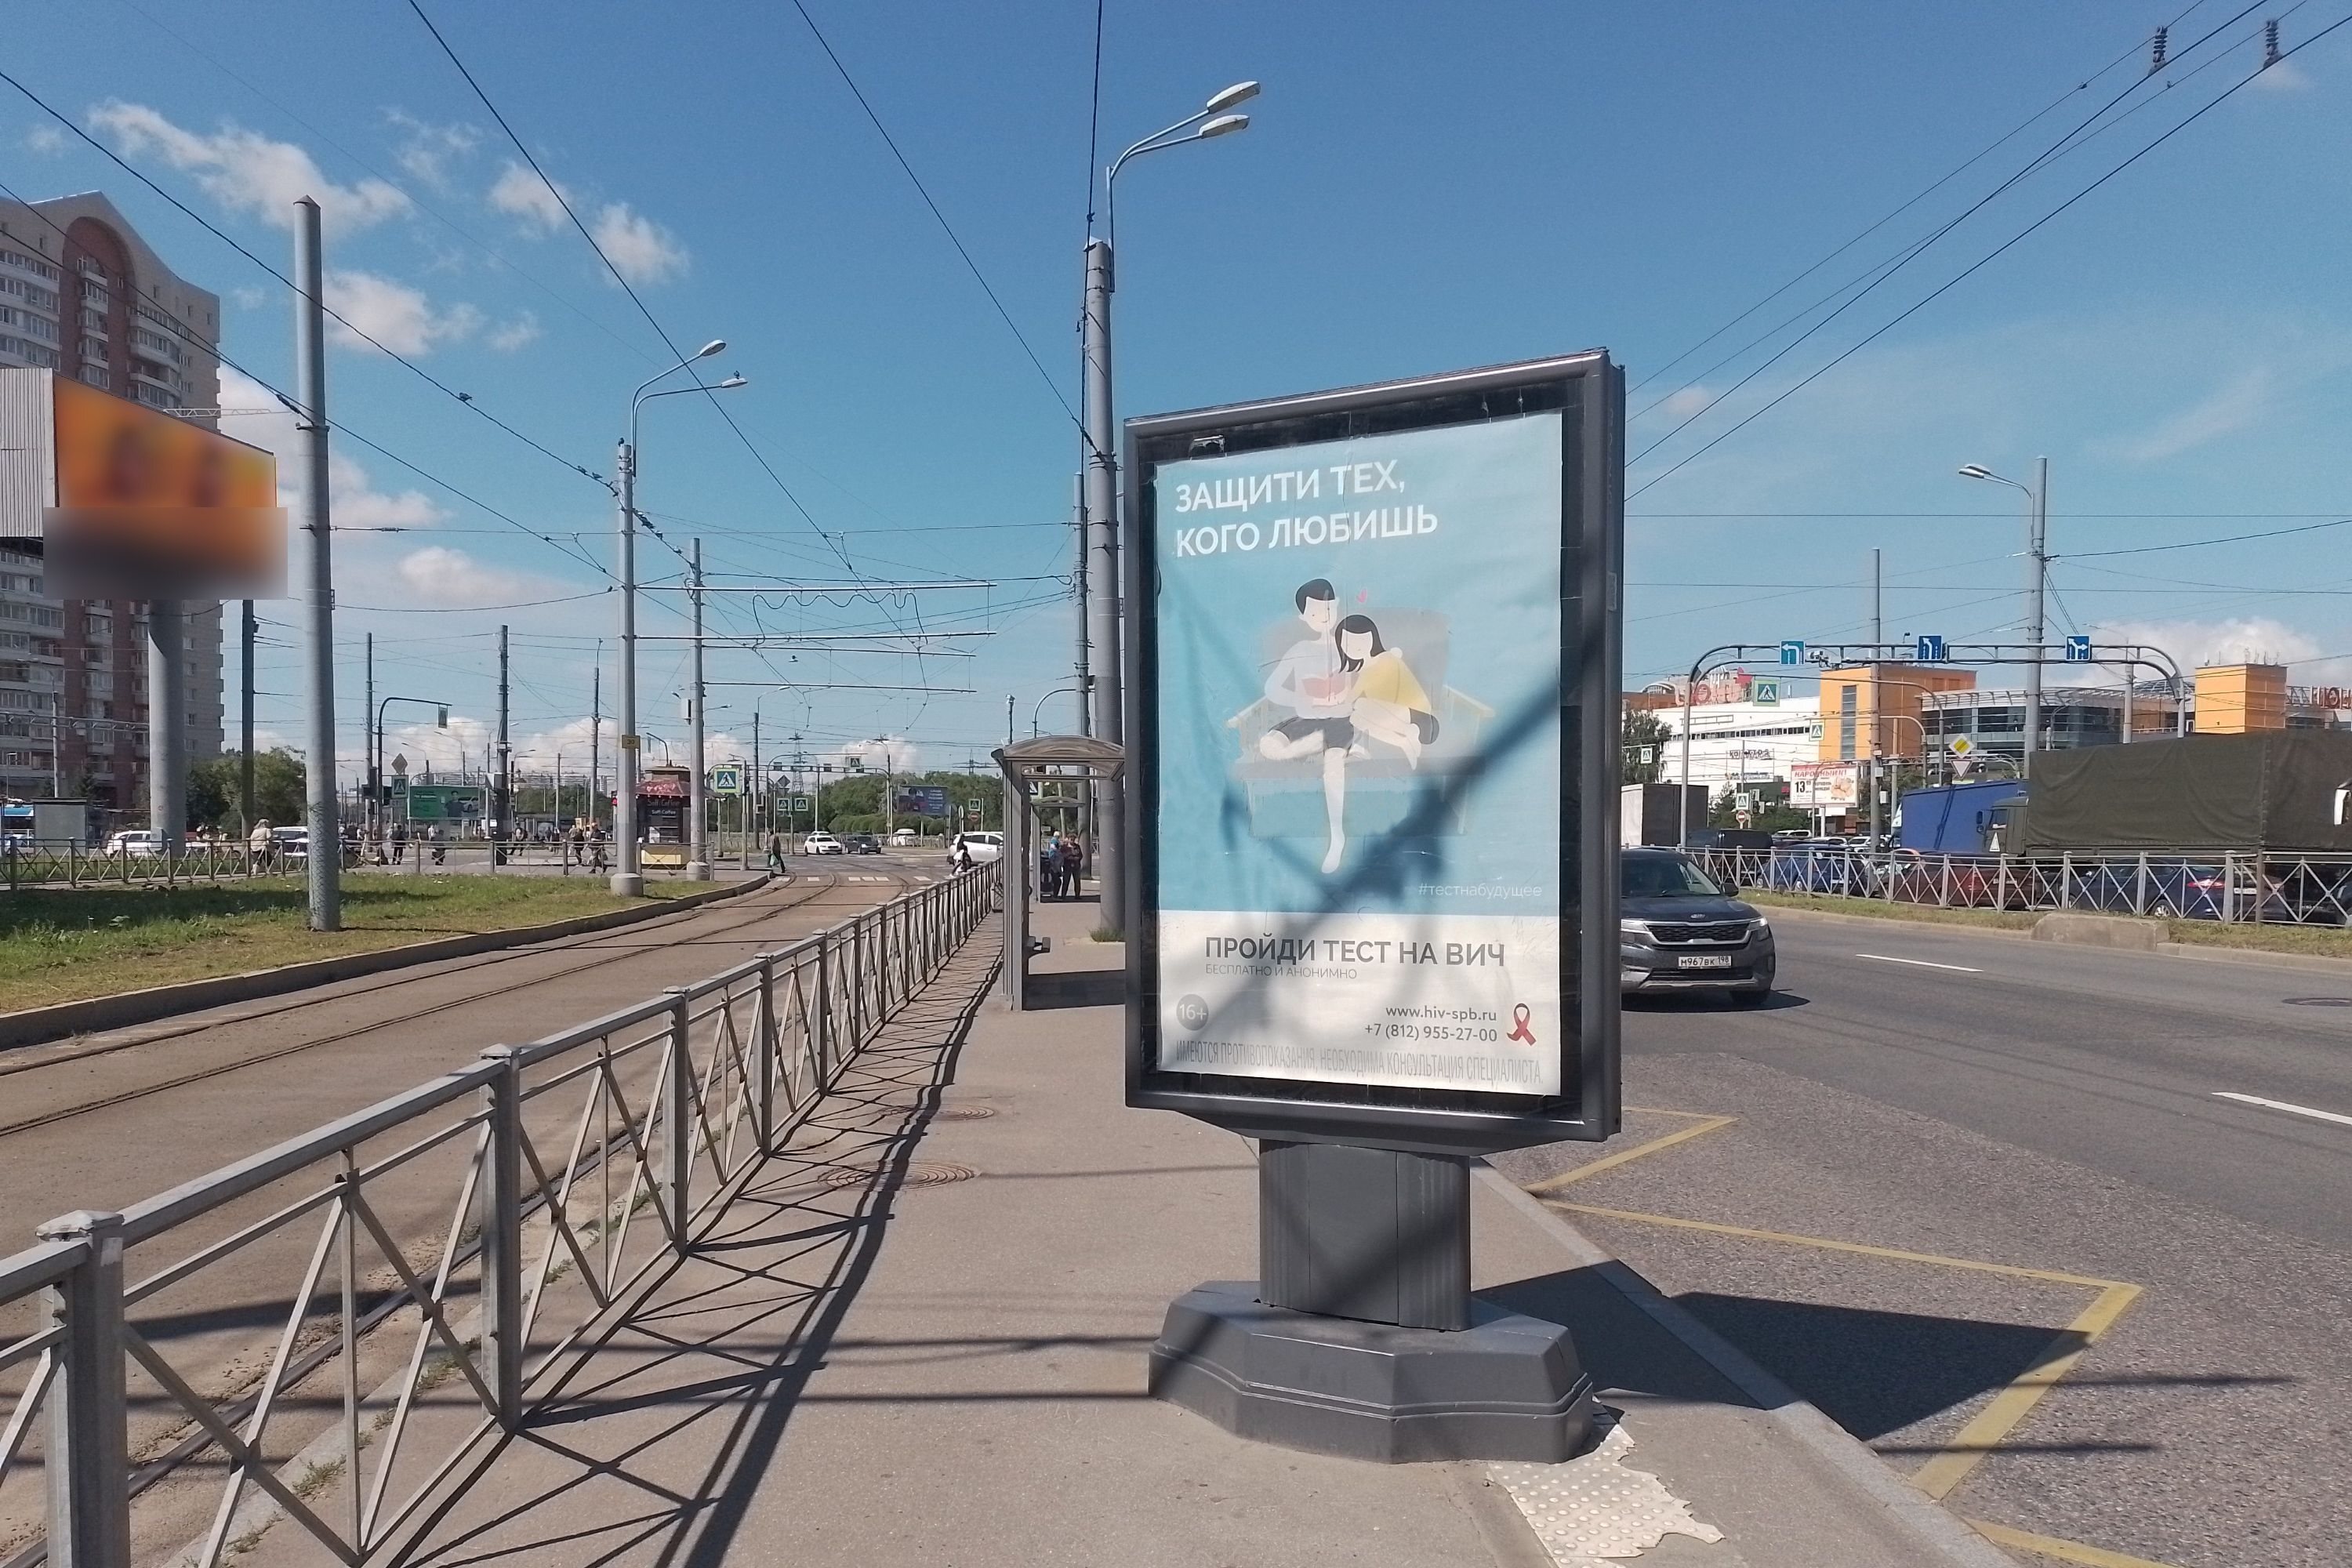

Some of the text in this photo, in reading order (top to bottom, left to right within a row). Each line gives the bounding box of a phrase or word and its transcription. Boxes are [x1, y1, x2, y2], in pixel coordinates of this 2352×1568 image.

[1174, 459, 1405, 513] ЗАЩИТИ ТЕХ,
[1176, 504, 1438, 558] КОГО ЛЮБИШЬ
[1795, 780, 1806, 793] 13
[1417, 883, 1543, 900] #тестнабудущее
[1206, 932, 1504, 967] ПРОЙДИ ТЕСТ НА ВИЧ
[1206, 964, 1357, 979] БЕСПЛАТНО И АНОНИМНО
[1179, 1004, 1207, 1021] 16+
[1385, 1005, 1497, 1022] www.hiv-spb.ru
[1365, 1023, 1497, 1042] +7 (812) 955-27-00
[1176, 1040, 1544, 1087] ИМЕЮТСЯ ПРОТИВОПОКАЗАНИЯ, НЕОБХОДИМА КОНСУЛЬТАЦИЯ СПЕЦИАЛИСТА.
